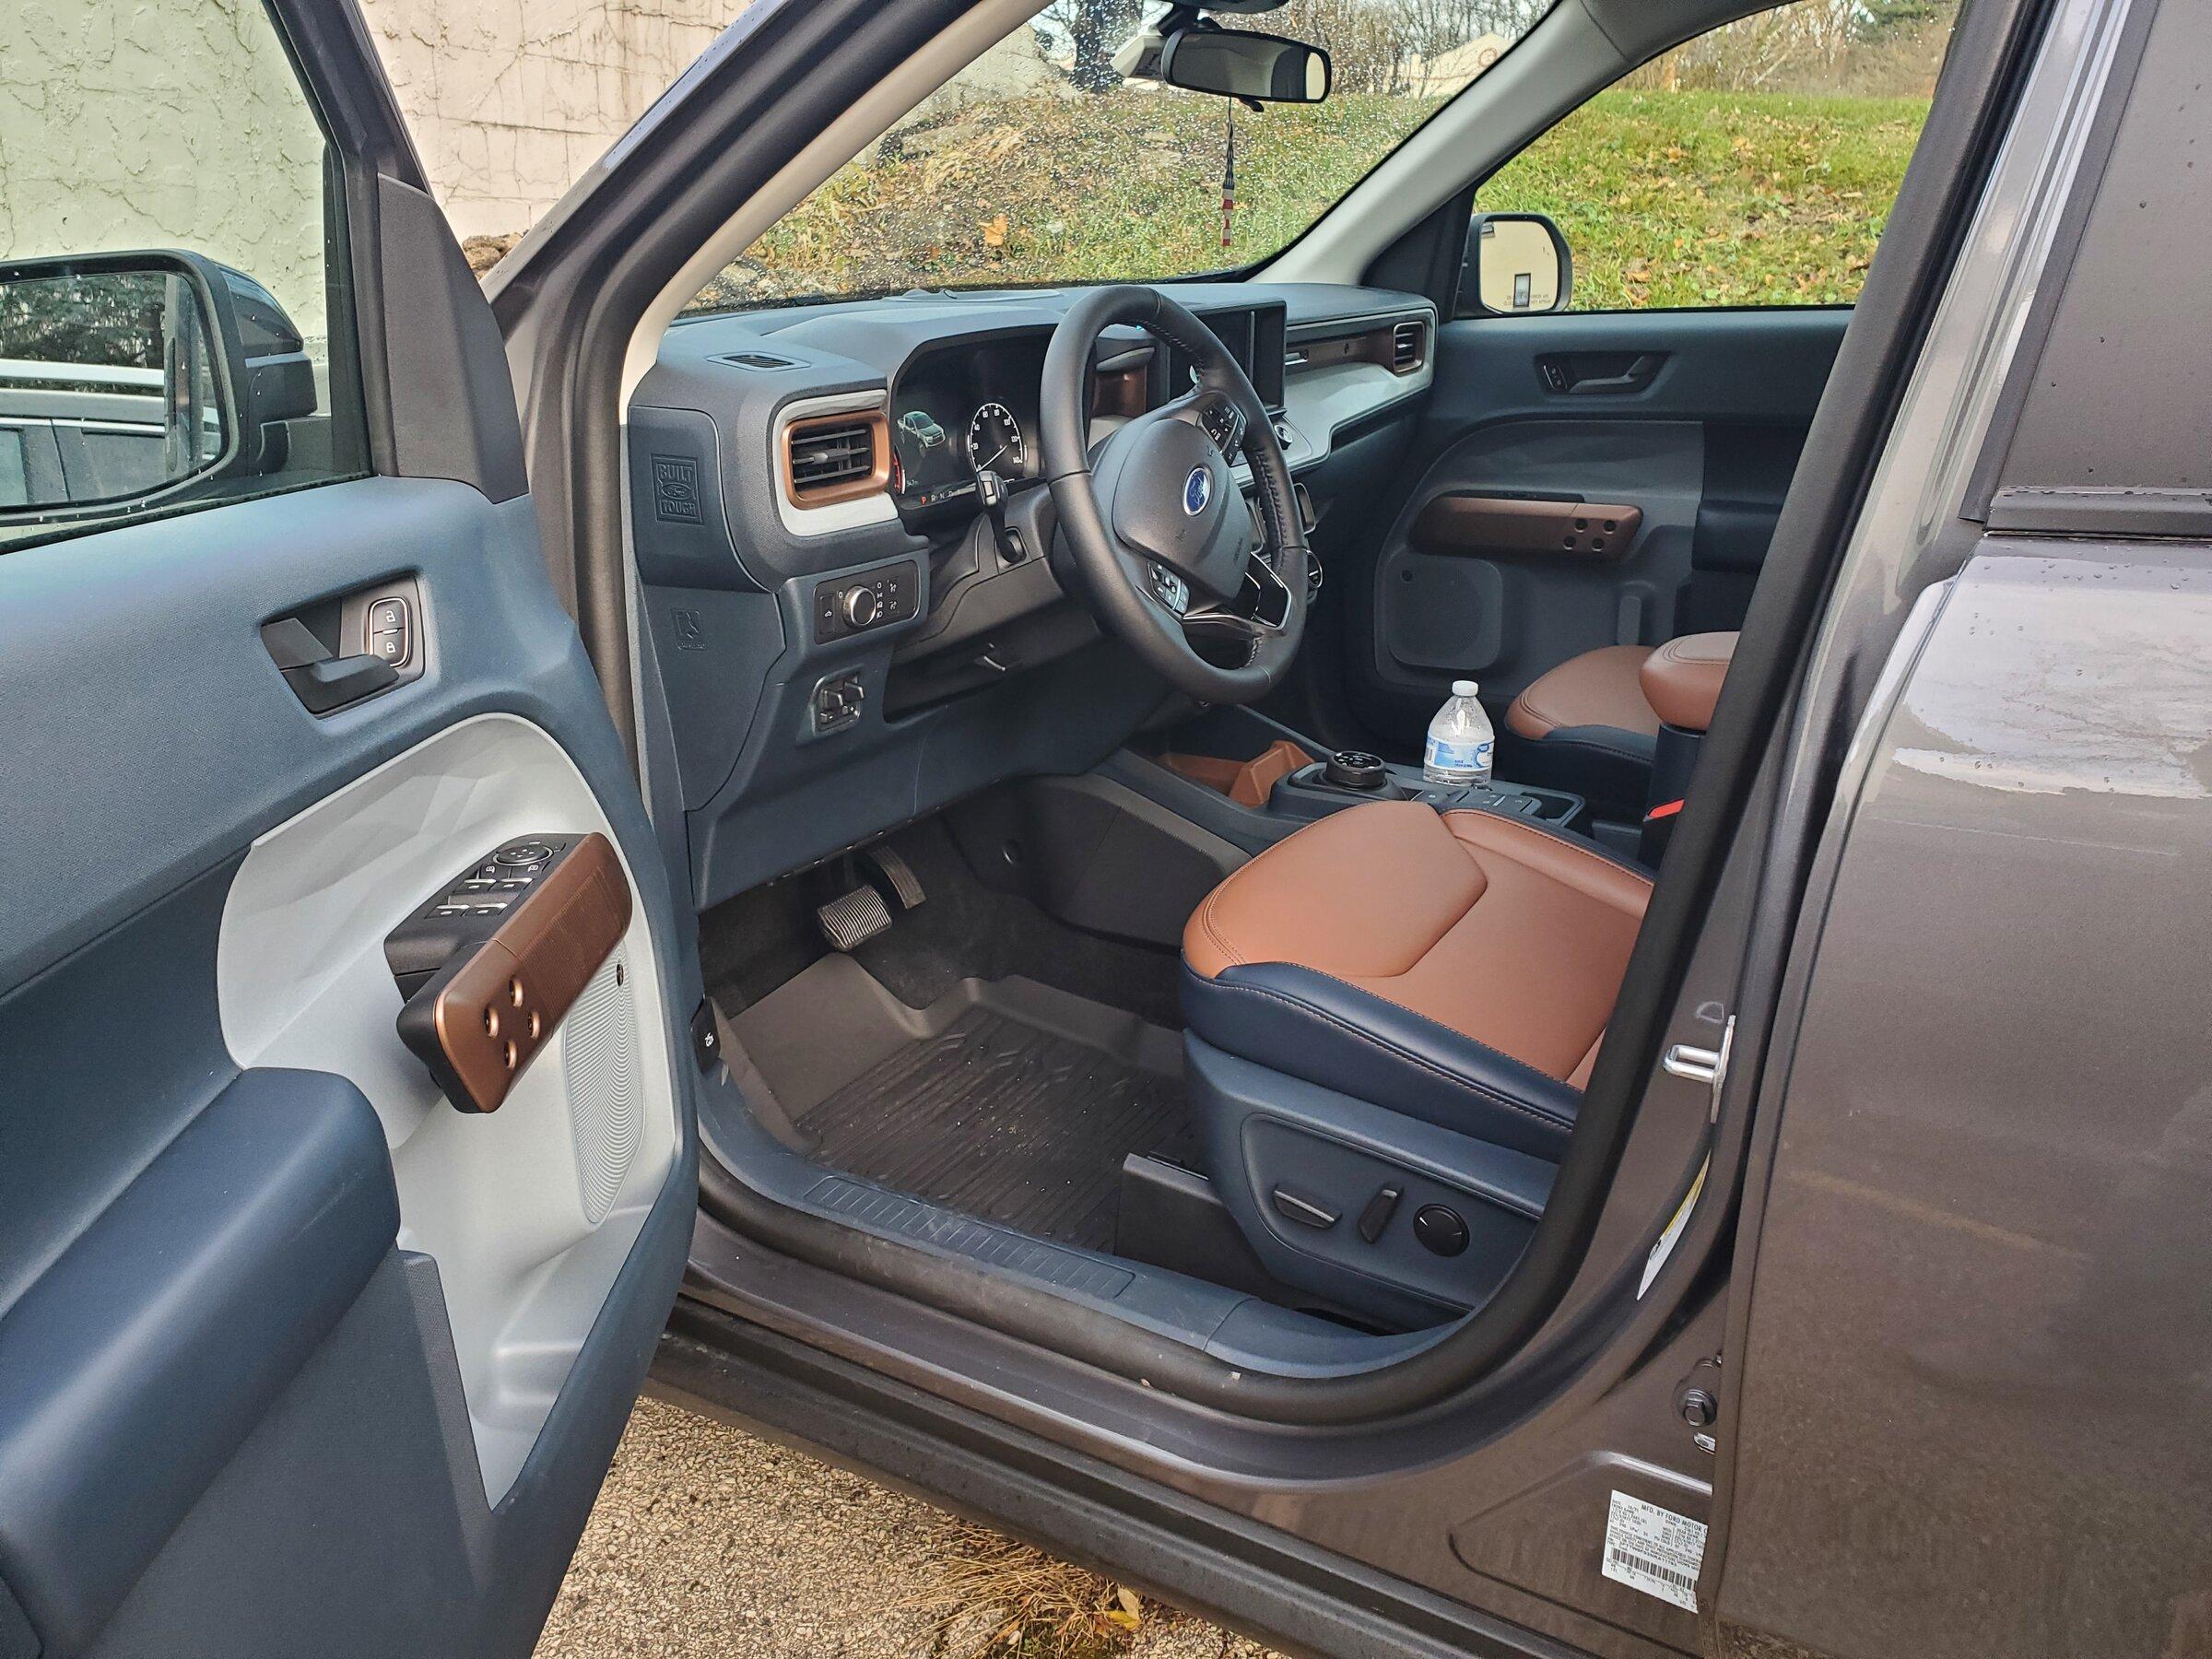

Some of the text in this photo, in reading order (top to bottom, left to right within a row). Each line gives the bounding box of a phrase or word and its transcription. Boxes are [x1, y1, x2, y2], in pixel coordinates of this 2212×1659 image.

[657, 464, 692, 483] BUILT
[661, 500, 697, 515] TOUGH
[1641, 1504, 1655, 1514] MFD.
[1665, 1513, 1680, 1524] FORD
[1682, 1520, 1702, 1532] MOTOR
